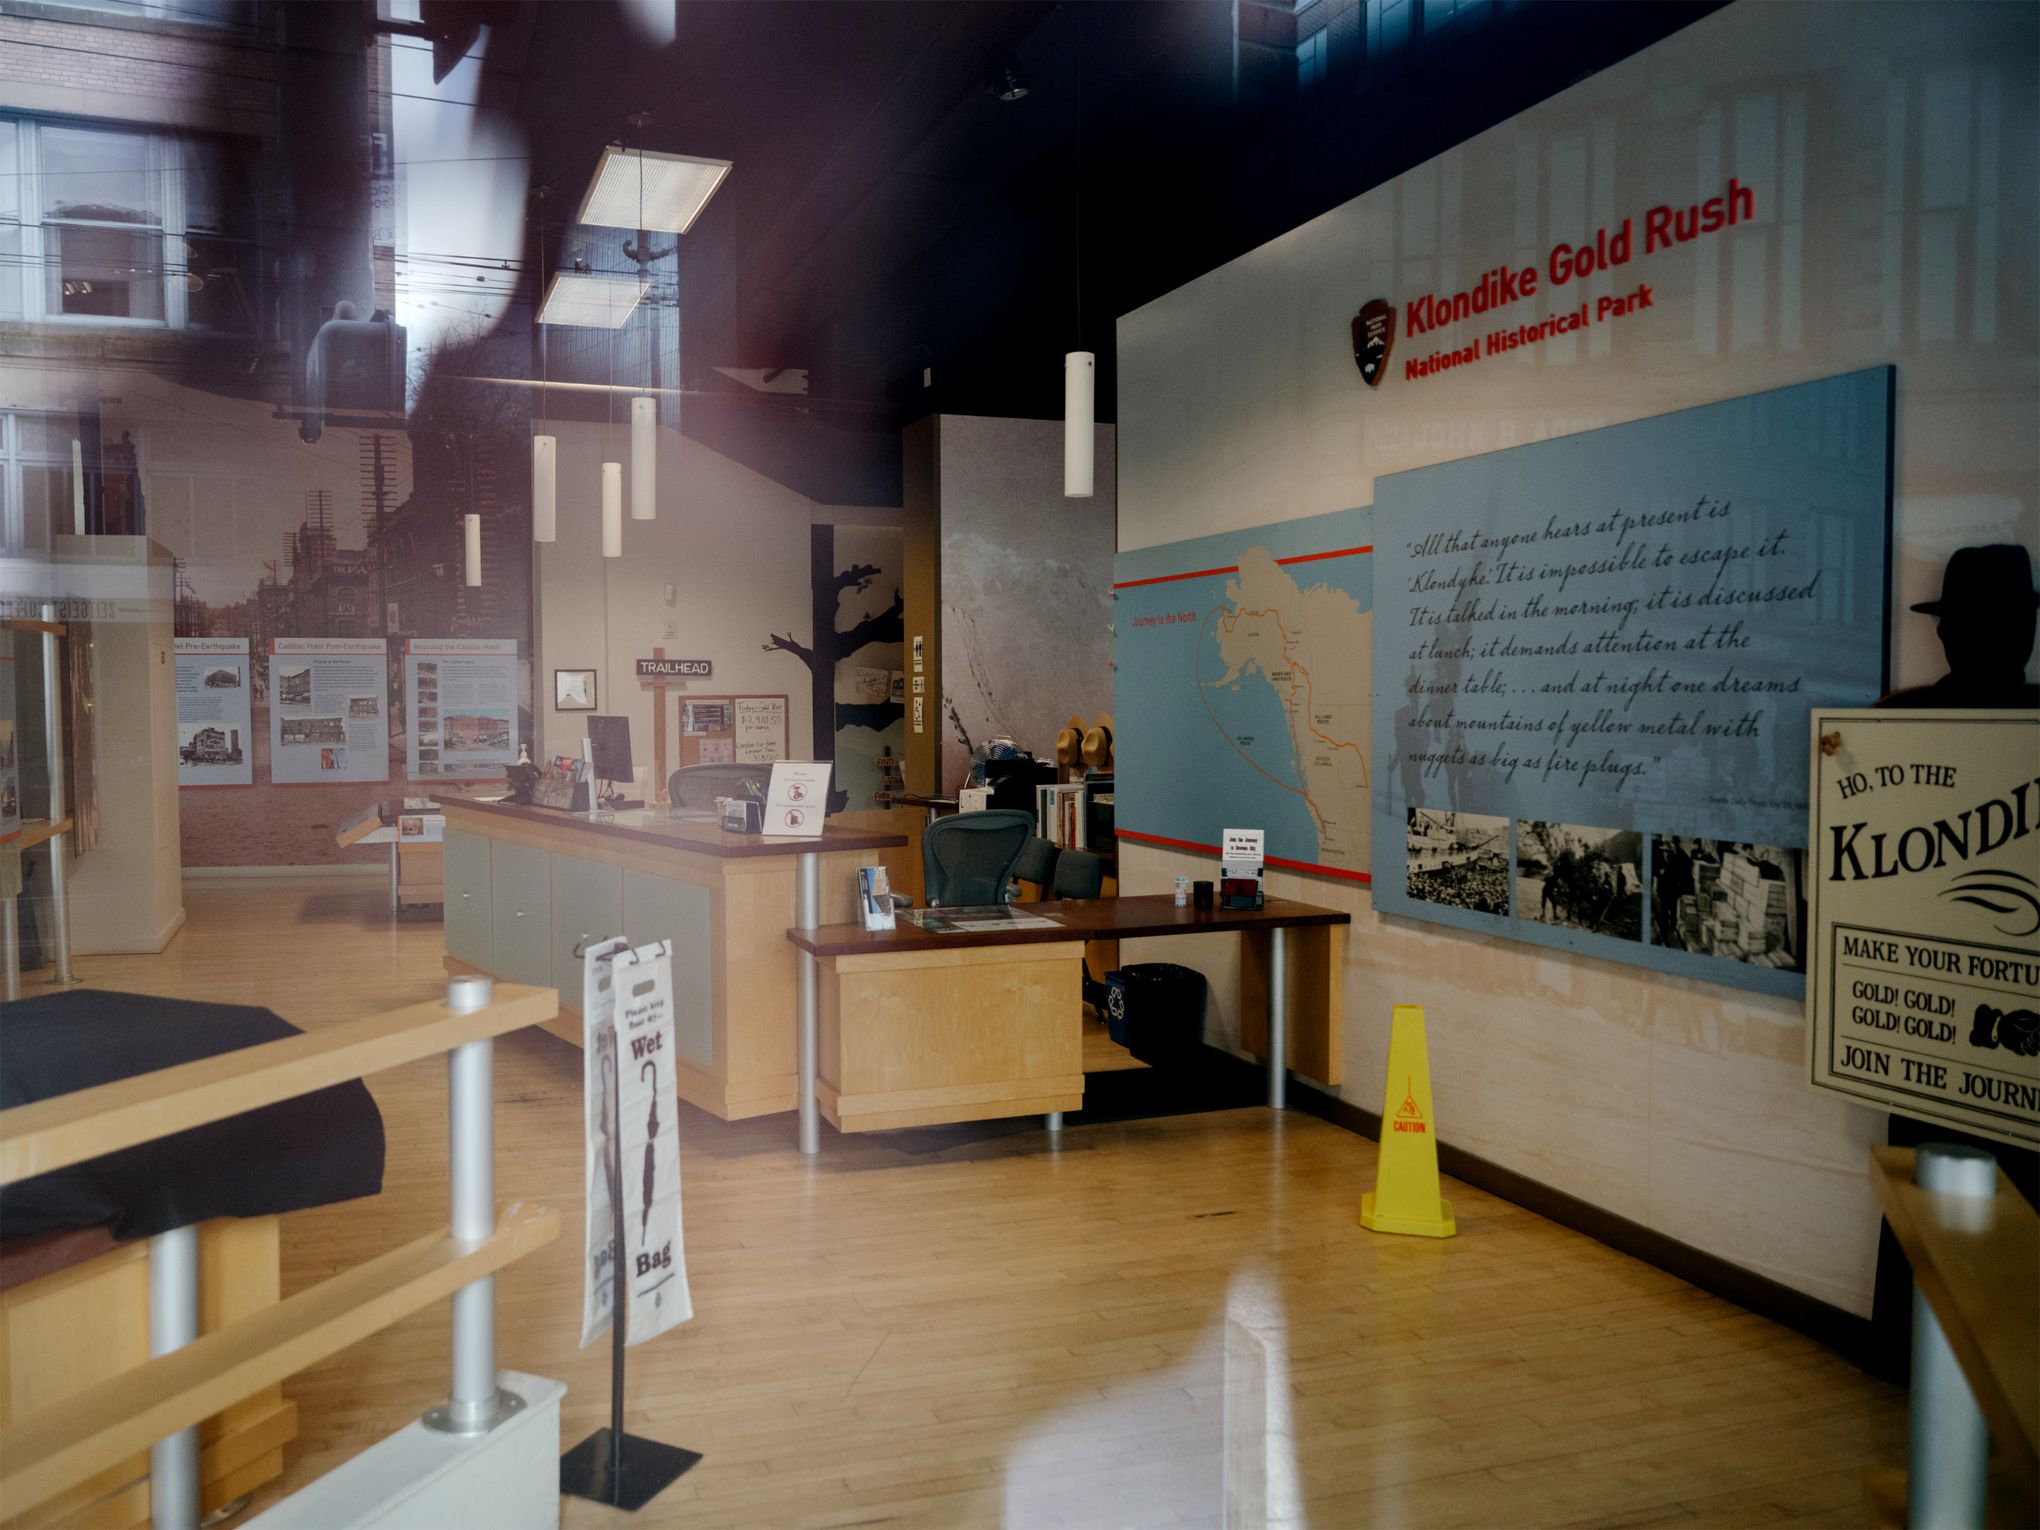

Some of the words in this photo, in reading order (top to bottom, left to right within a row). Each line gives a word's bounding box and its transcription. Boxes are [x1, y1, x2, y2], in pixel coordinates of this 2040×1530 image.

[1405, 265, 1538, 338] Klondike
[1548, 217, 1632, 286] Gold
[1645, 177, 1754, 256] Rush
[1404, 338, 1480, 382] National
[1486, 304, 1588, 356] Historical
[1596, 284, 1654, 323] Park
[1444, 529, 1480, 554] that
[1480, 531, 1537, 562] anyone
[1542, 514, 1591, 540] hears
[1596, 508, 1622, 533] at
[1616, 495, 1709, 547] present
[1708, 500, 1732, 519] is
[1496, 561, 1519, 584] It
[1518, 566, 1535, 582] is
[1539, 541, 1646, 592] impossible
[1651, 543, 1674, 567] to
[1679, 546, 1750, 580] escape
[1756, 528, 1790, 557] it.
[1409, 606, 1431, 627] It
[1428, 611, 1442, 625] is
[1446, 598, 1499, 624] talked
[1498, 605, 1518, 620] in
[1520, 594, 1547, 618] the
[1552, 596, 1639, 631] morning;
[1647, 584, 1674, 610] it
[1672, 590, 1693, 609] is
[1697, 569, 1823, 607] discussed
[186, 642, 241, 652] Pre-Earthquake
[278, 642, 305, 650] Cadillac
[307, 642, 324, 650] Hotel
[326, 643, 381, 652] Post-Earthquake
[1409, 640, 1428, 660] at
[1428, 635, 1476, 661] lunch;
[1479, 636, 1501, 658] it
[1500, 631, 1578, 657] demands
[1583, 628, 1677, 653] attention
[1684, 624, 1715, 650] at
[1713, 620, 1750, 649] the
[641, 662, 709, 674] TRAILHEAD
[1408, 672, 1458, 694] dinner
[1541, 670, 1580, 694] and
[1581, 671, 1606, 693] at
[1607, 667, 1671, 711] night
[1671, 681, 1705, 693] one
[1713, 665, 1801, 693] dreams
[1408, 704, 1455, 729] about
[1456, 710, 1544, 732] mountains
[1548, 710, 1569, 745] of
[1570, 708, 1632, 748] yellow
[1637, 710, 1705, 735] metal
[1705, 709, 1764, 737] with
[1408, 745, 1465, 779] nuggets
[1469, 754, 1486, 766] as
[1491, 742, 1519, 784] big
[1522, 759, 1541, 770] as
[1543, 749, 1578, 783] fire
[1836, 772, 1874, 799] HO,
[1874, 764, 1904, 787] TO
[1910, 764, 1957, 788] THE
[1829, 777, 2040, 881] KLONDI
[1843, 936, 1899, 963] MAKE
[1905, 945, 1962, 974] YOUR
[1852, 980, 1899, 1007] GOLD!
[1904, 988, 1956, 1018] GOLD!
[631, 1031, 663, 1061] Wet
[1852, 1006, 1901, 1034] GOLD!
[1904, 1016, 1957, 1045] GOLD!
[1841, 1045, 1891, 1076] JOIN
[1900, 1058, 1948, 1090] THE
[1959, 1072, 2040, 1112] JOURN
[1393, 1120, 1425, 1133] CAUTION
[636, 1241, 672, 1278] Bag
